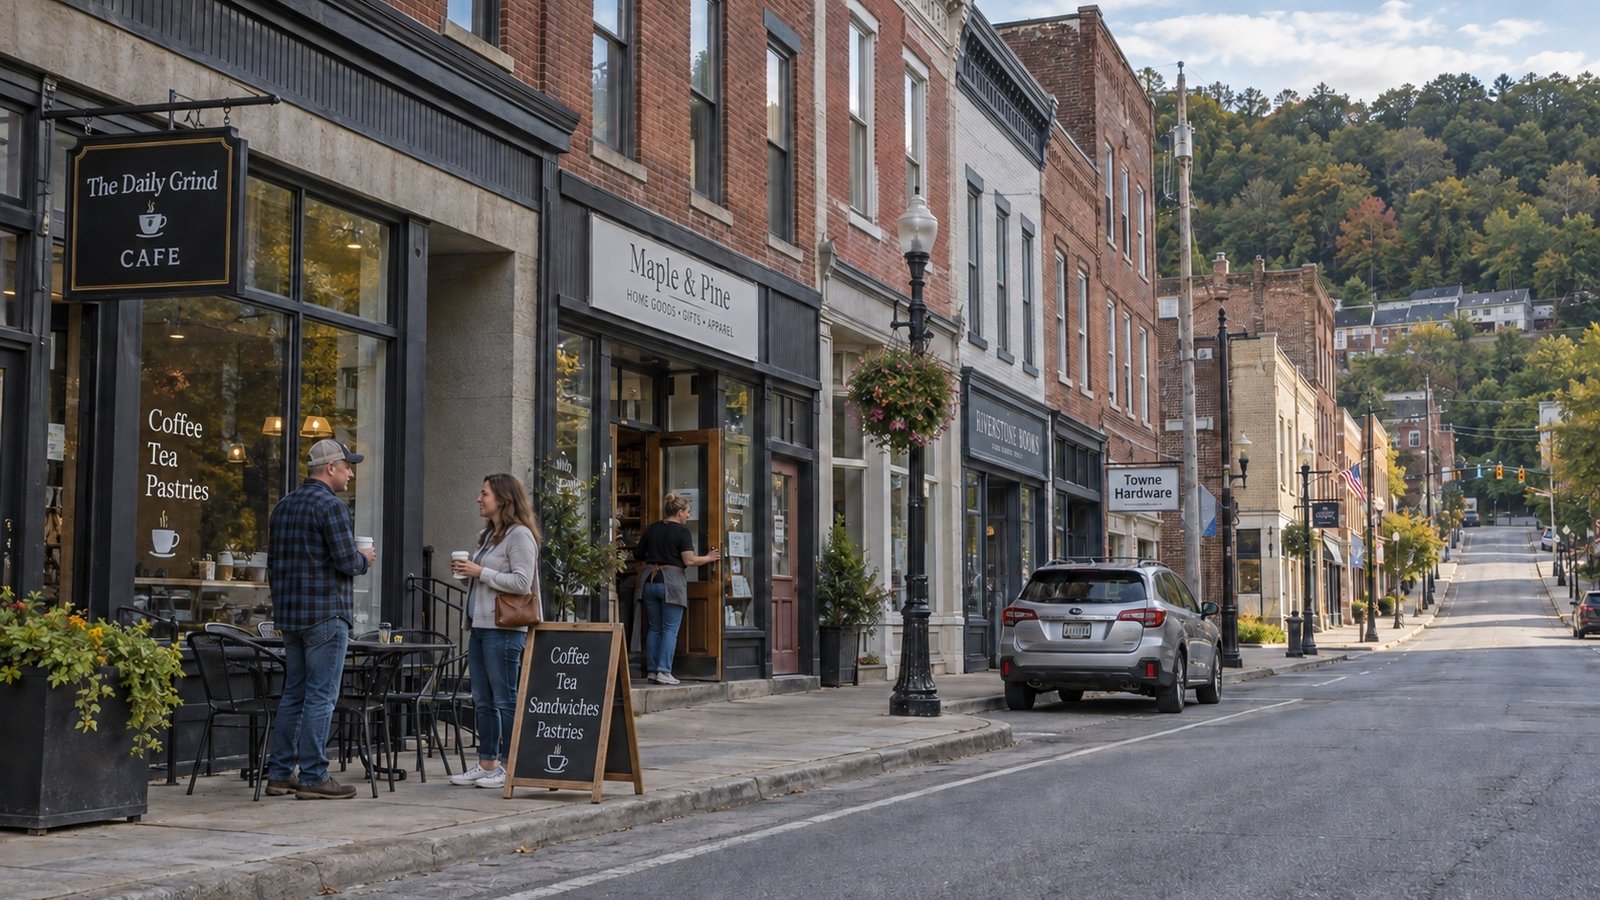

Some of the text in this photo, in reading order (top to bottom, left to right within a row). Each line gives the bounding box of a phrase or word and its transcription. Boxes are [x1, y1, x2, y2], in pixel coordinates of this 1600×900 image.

[87, 169, 218, 198] The Daily Grind
[121, 248, 180, 268] CAFE
[630, 243, 731, 310] Maple & Pine
[627, 289, 734, 337] HOME GOODS GIFTS APPAREL
[149, 409, 203, 438] Coffee
[976, 410, 1016, 446] RIVERSTONE
[1018, 428, 1040, 456] BOOKS
[148, 442, 178, 468] Tea
[146, 474, 209, 501] Pastries
[1123, 474, 1162, 486] Towne
[1115, 487, 1172, 499] Hardware
[551, 647, 589, 665] Coffee
[556, 672, 577, 690] Tea
[529, 697, 599, 716] Sandwiches
[535, 721, 584, 740] Pastries
